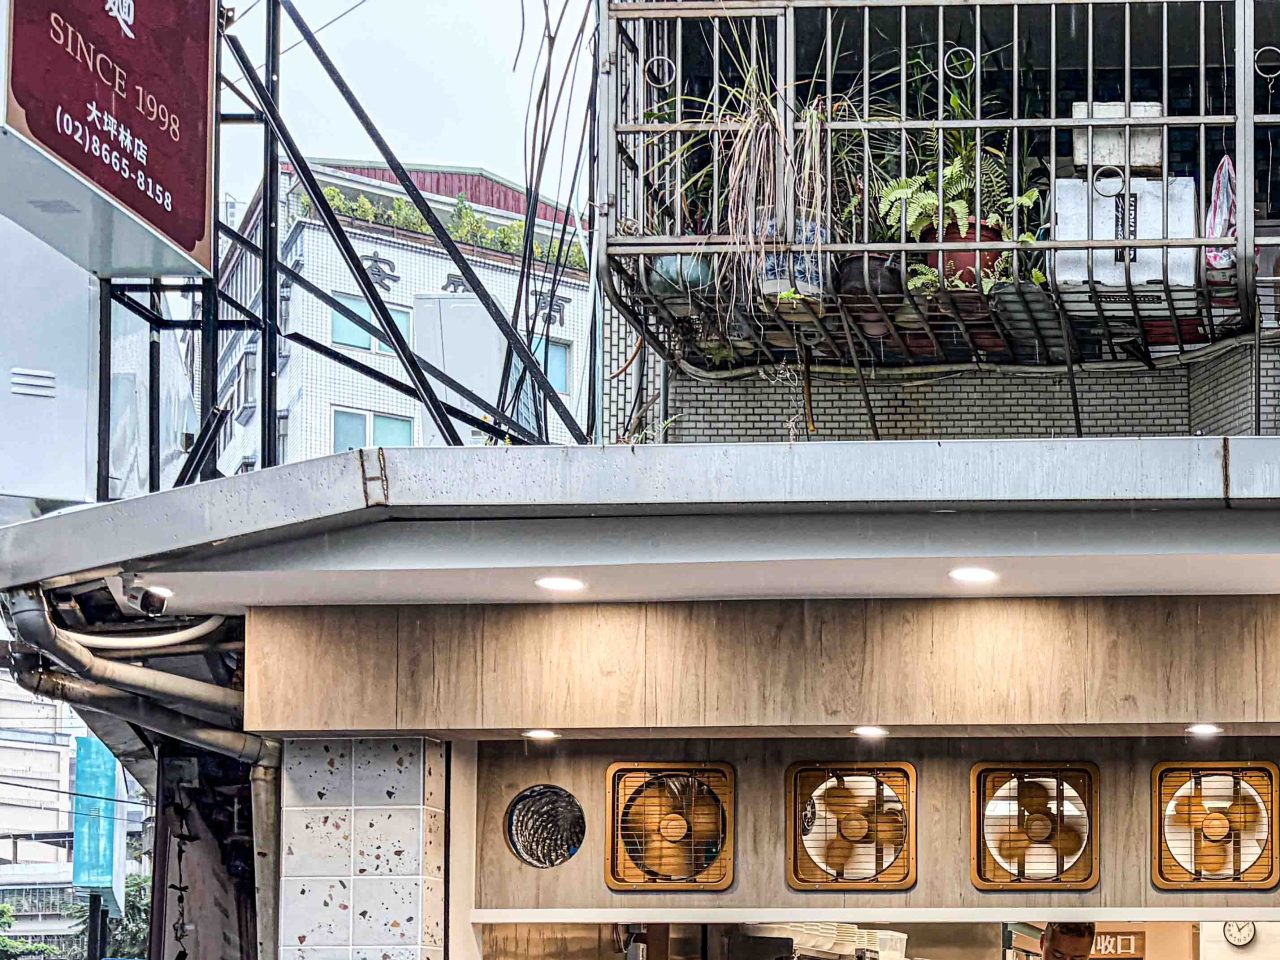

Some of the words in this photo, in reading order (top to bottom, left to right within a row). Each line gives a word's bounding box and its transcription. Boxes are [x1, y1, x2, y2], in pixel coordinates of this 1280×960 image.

[50, 13, 127, 98] SINCE
[135, 85, 180, 142] 1998
[56, 105, 172, 212] (02)8665-8158
[86, 101, 148, 166] 大坪林店
[1090, 935, 1136, 954] 收口
